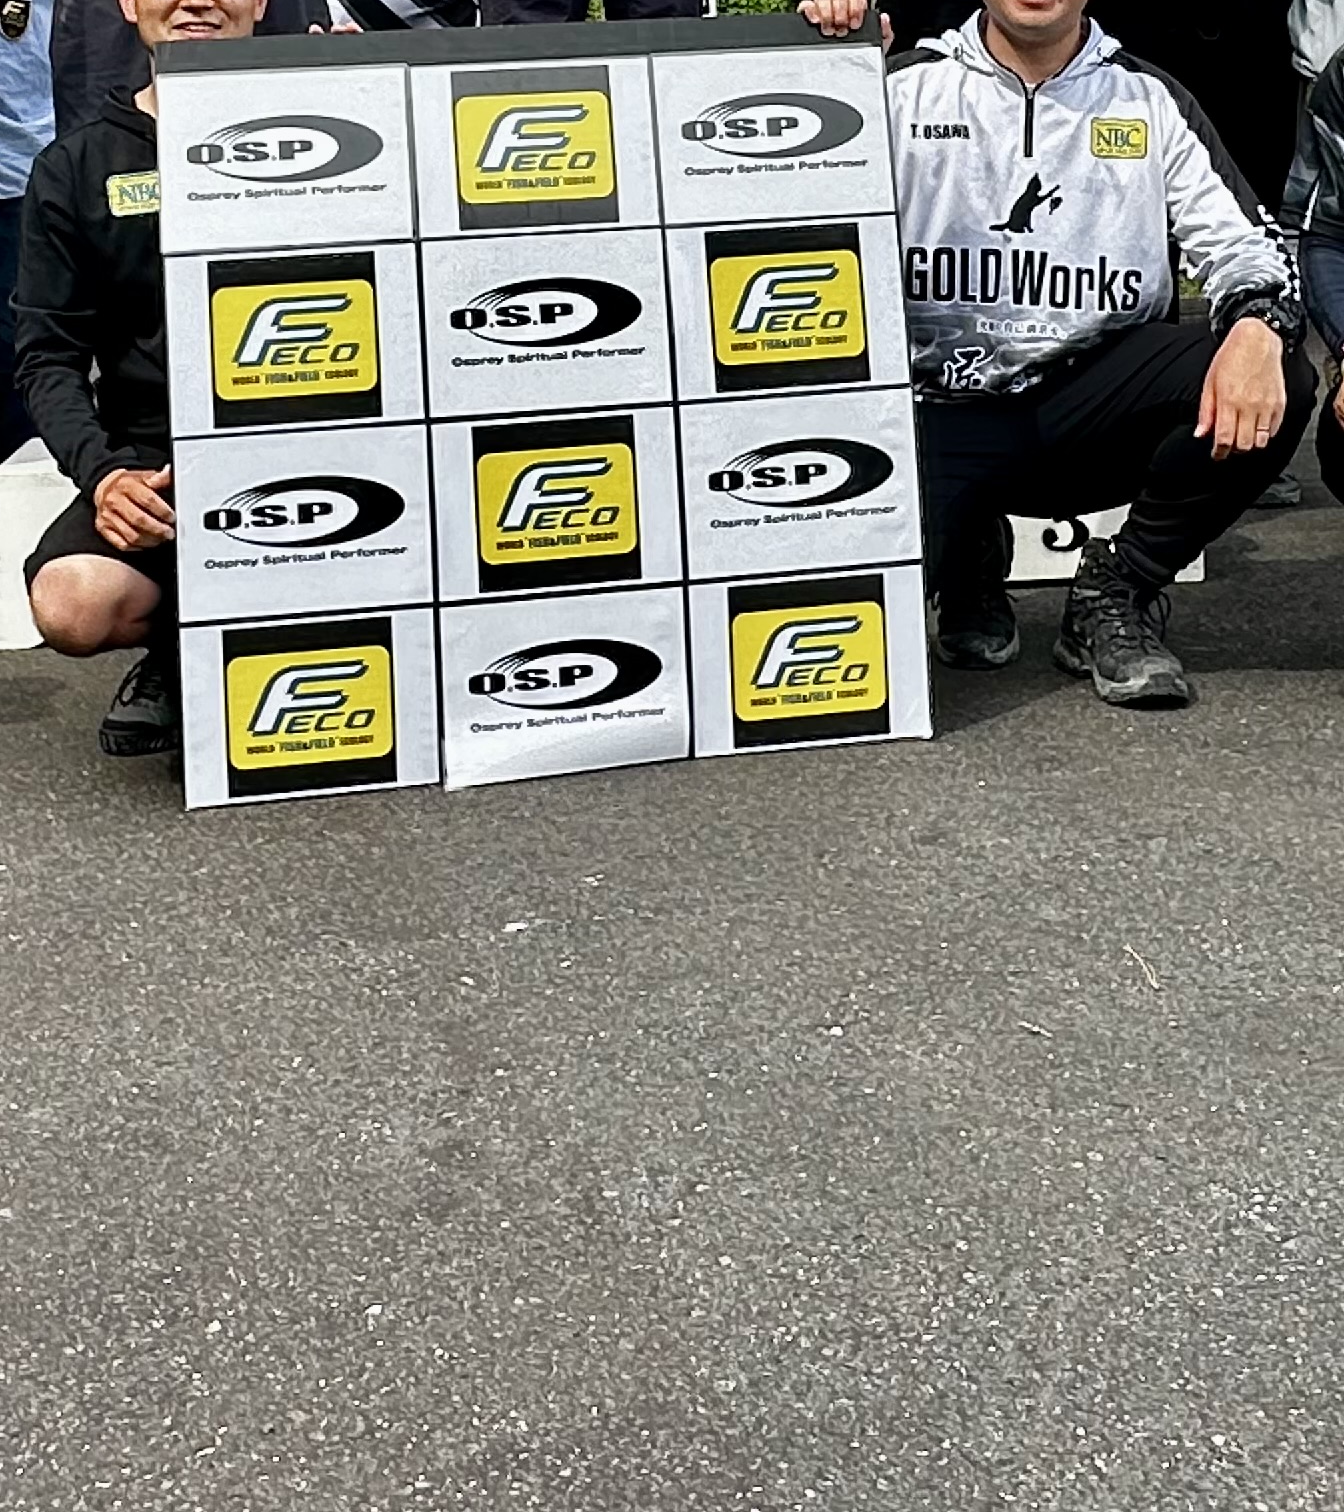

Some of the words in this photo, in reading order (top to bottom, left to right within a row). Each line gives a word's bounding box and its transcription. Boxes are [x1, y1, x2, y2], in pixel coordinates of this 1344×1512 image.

[681, 116, 799, 141] O.S.P
[1096, 128, 1142, 148] NBC
[187, 140, 313, 165] O.S.P
[737, 162, 795, 174] Spiritual
[799, 159, 868, 170] Performer
[245, 186, 307, 198] Spiritual
[312, 184, 388, 195] Performer
[906, 247, 1002, 303] GOLD
[1012, 249, 1142, 312] Works
[450, 303, 574, 330] O.S.P
[508, 351, 568, 363] Spiritual
[572, 346, 646, 359] Performer
[708, 463, 828, 492] O.S.P
[203, 502, 333, 531] O.S.P
[763, 511, 822, 524] Spiritual
[826, 505, 898, 519] Performer
[262, 551, 326, 565] Spiritual
[330, 546, 408, 559] Performer
[468, 664, 594, 695] O.S.P
[526, 713, 587, 728] Spiritual
[592, 707, 666, 722] Performer
